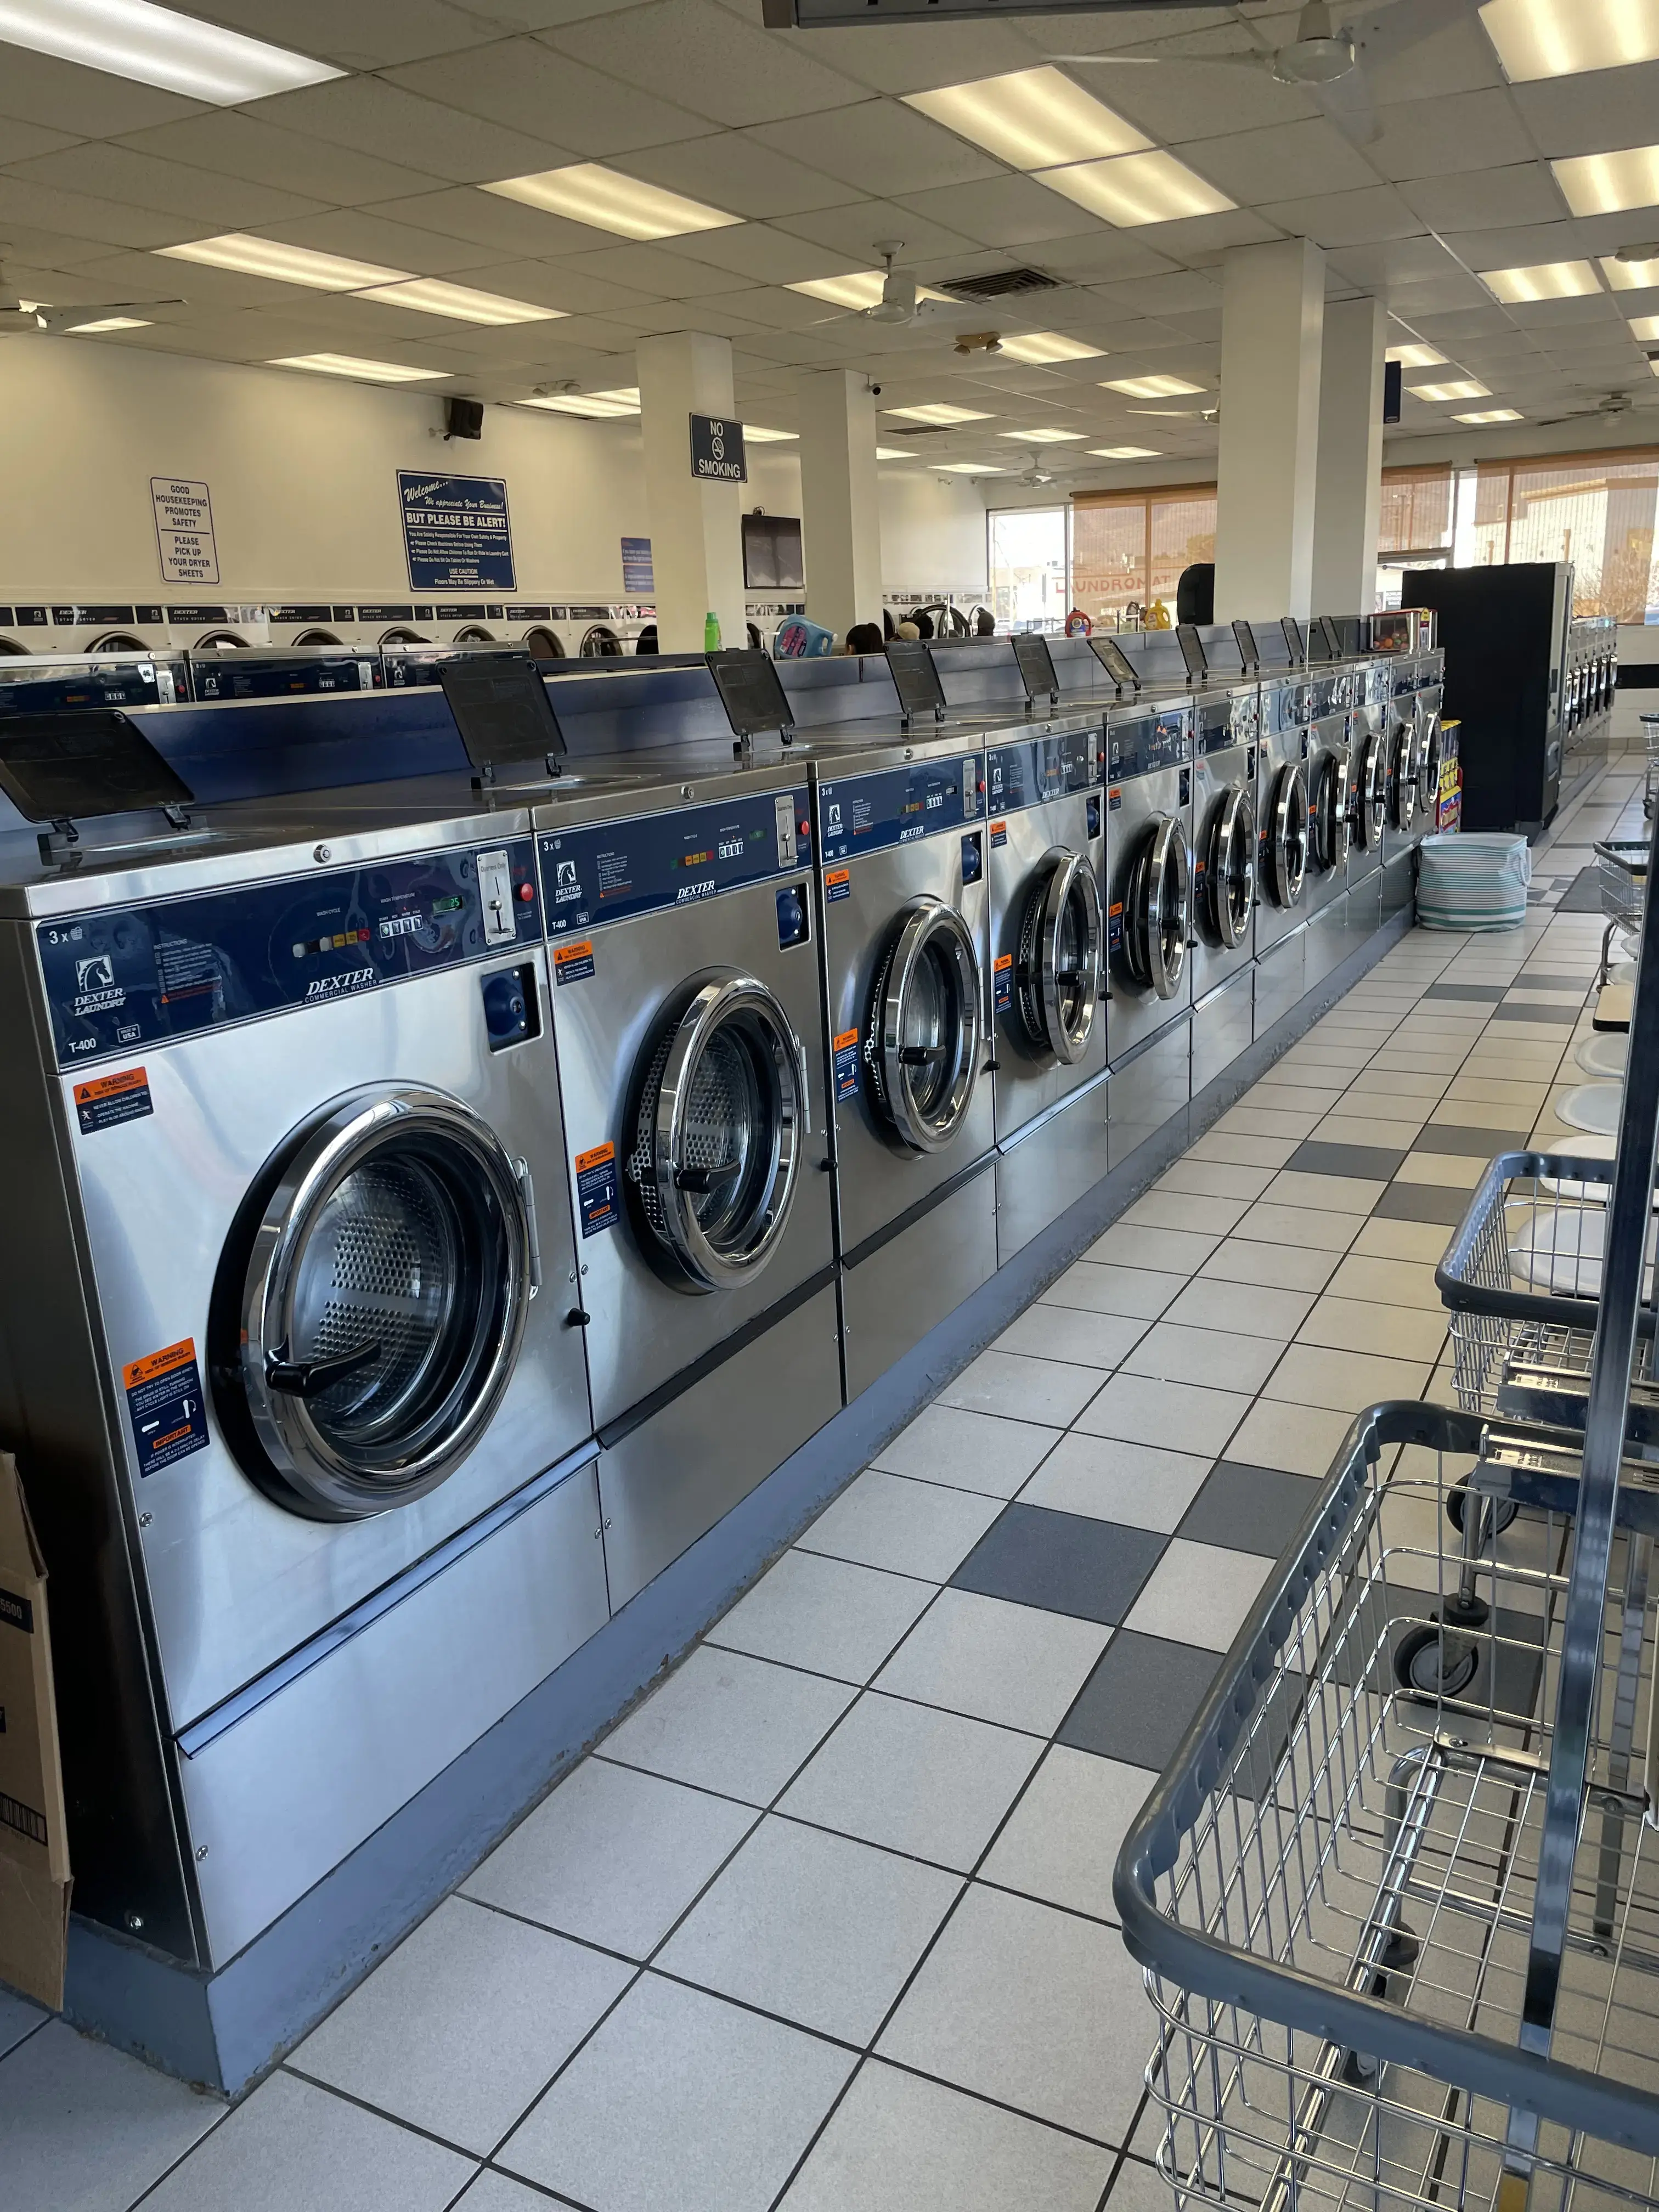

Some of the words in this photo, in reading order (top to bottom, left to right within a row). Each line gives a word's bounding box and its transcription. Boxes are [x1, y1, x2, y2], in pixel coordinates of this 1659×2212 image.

[710, 421, 723, 437] NO
[699, 459, 740, 478] SMOKING
[171, 485, 189, 494] GOOD
[156, 495, 207, 506] HOUSEKEEPING
[425, 496, 434, 505] We
[165, 507, 201, 517] PROMOTES
[172, 518, 196, 527] SAFETY
[407, 513, 425, 523] BUT
[427, 514, 461, 526] PLEASE
[464, 516, 475, 526] BE
[477, 517, 505, 528] ALERT!
[174, 537, 199, 545] PLEASE
[168, 557, 187, 566] YOUR
[189, 559, 210, 567] DRYER
[179, 569, 203, 577] SHEETS
[1056, 576, 1170, 594] LUNDROMAT
[822, 788, 825, 796] 3
[1042, 788, 1059, 799] DEXTER
[827, 823, 843, 832] DEXTER
[900, 826, 923, 839] DEXTER
[544, 842, 549, 851] 3
[555, 885, 582, 896] DEXTER
[677, 880, 715, 899] DEXTER
[556, 892, 582, 904] LAUNDRY
[552, 919, 566, 929] T-400
[49, 931, 58, 944] 3
[61, 933, 69, 943] x
[306, 968, 373, 996] DEXTER
[305, 988, 348, 1003] COMMERCIAL
[351, 979, 377, 991] WASHER
[74, 988, 123, 1007] DEXTER
[75, 997, 126, 1016] LAUNDRY
[69, 1038, 96, 1053] T-400
[100, 1074, 134, 1088] WARNING
[151, 1348, 184, 1365] WARNING
[156, 1426, 188, 1447] IMPORTANT
